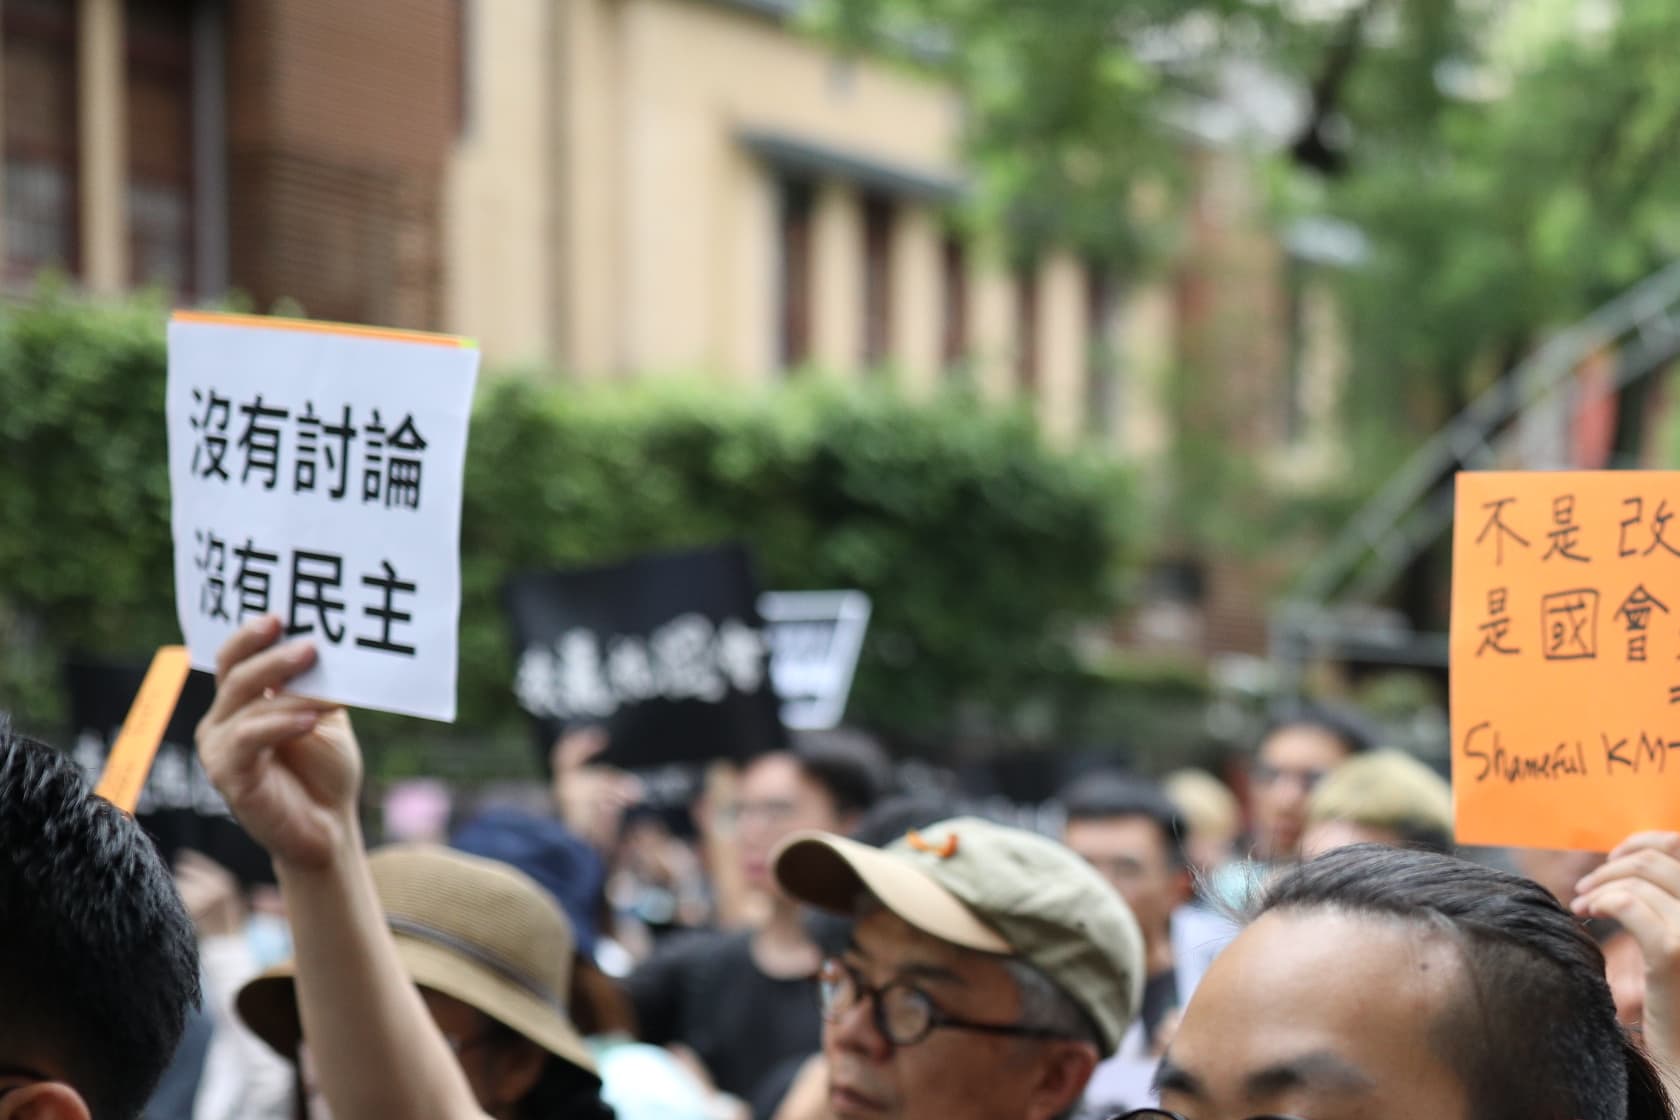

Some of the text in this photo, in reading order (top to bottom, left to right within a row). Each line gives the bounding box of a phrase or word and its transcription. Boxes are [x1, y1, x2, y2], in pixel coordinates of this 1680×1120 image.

[188, 387, 429, 512] 沒有討論
[195, 530, 418, 656] 沒有民主
